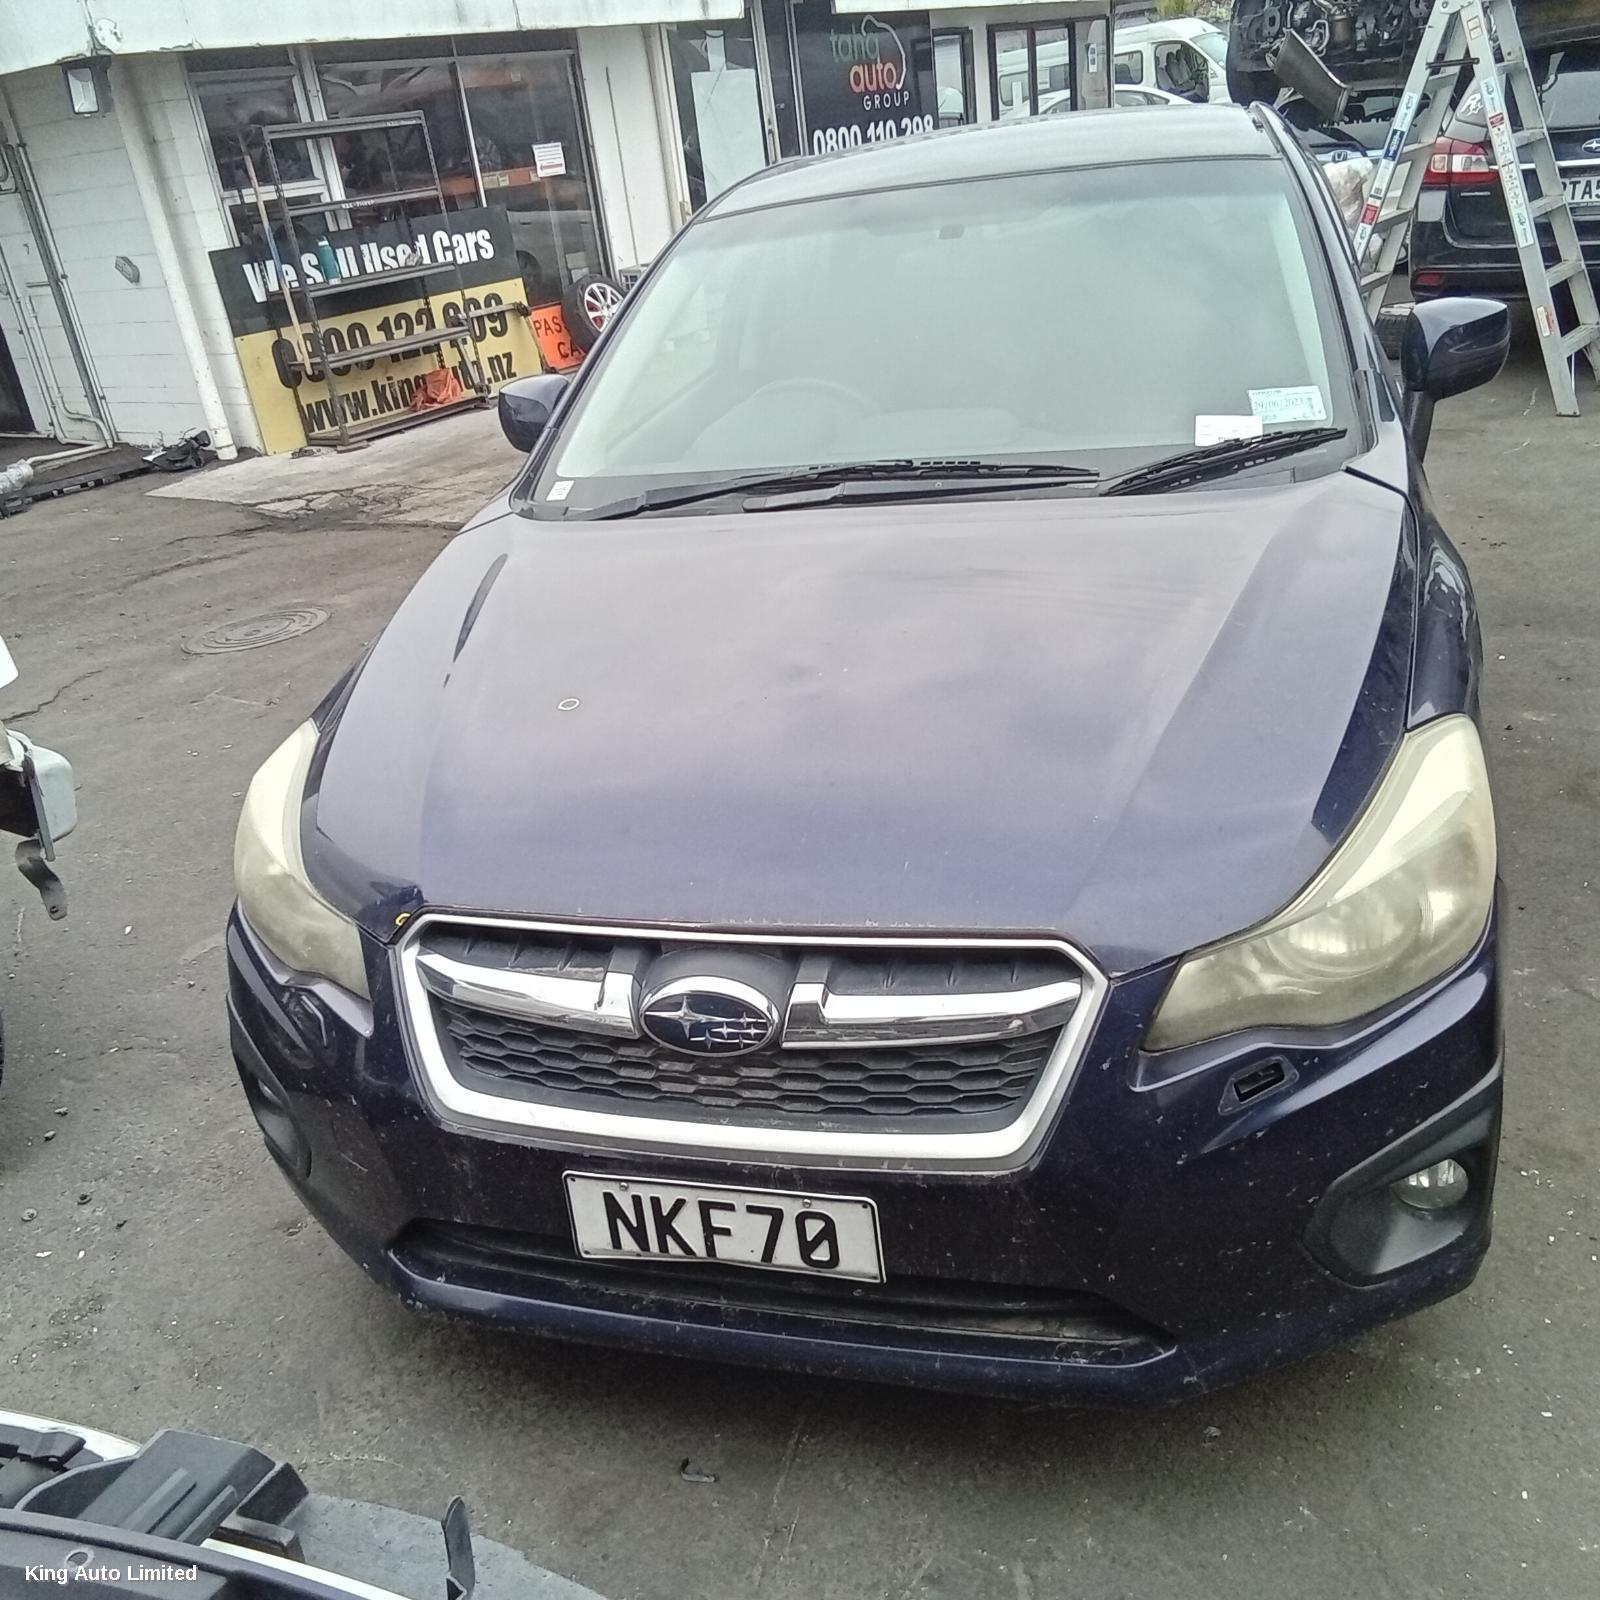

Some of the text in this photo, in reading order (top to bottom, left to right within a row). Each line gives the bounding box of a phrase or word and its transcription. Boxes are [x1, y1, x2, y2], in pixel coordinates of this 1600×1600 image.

[849, 60, 897, 93] auto
[863, 91, 910, 111] GROUP
[813, 124, 862, 157] 0800
[866, 119, 897, 143] 110
[242, 259, 300, 303] We
[301, 246, 360, 285] Sll
[432, 229, 495, 265] Cars
[301, 351, 517, 434] www.kinto.nz
[602, 1191, 840, 1269] NKF70
